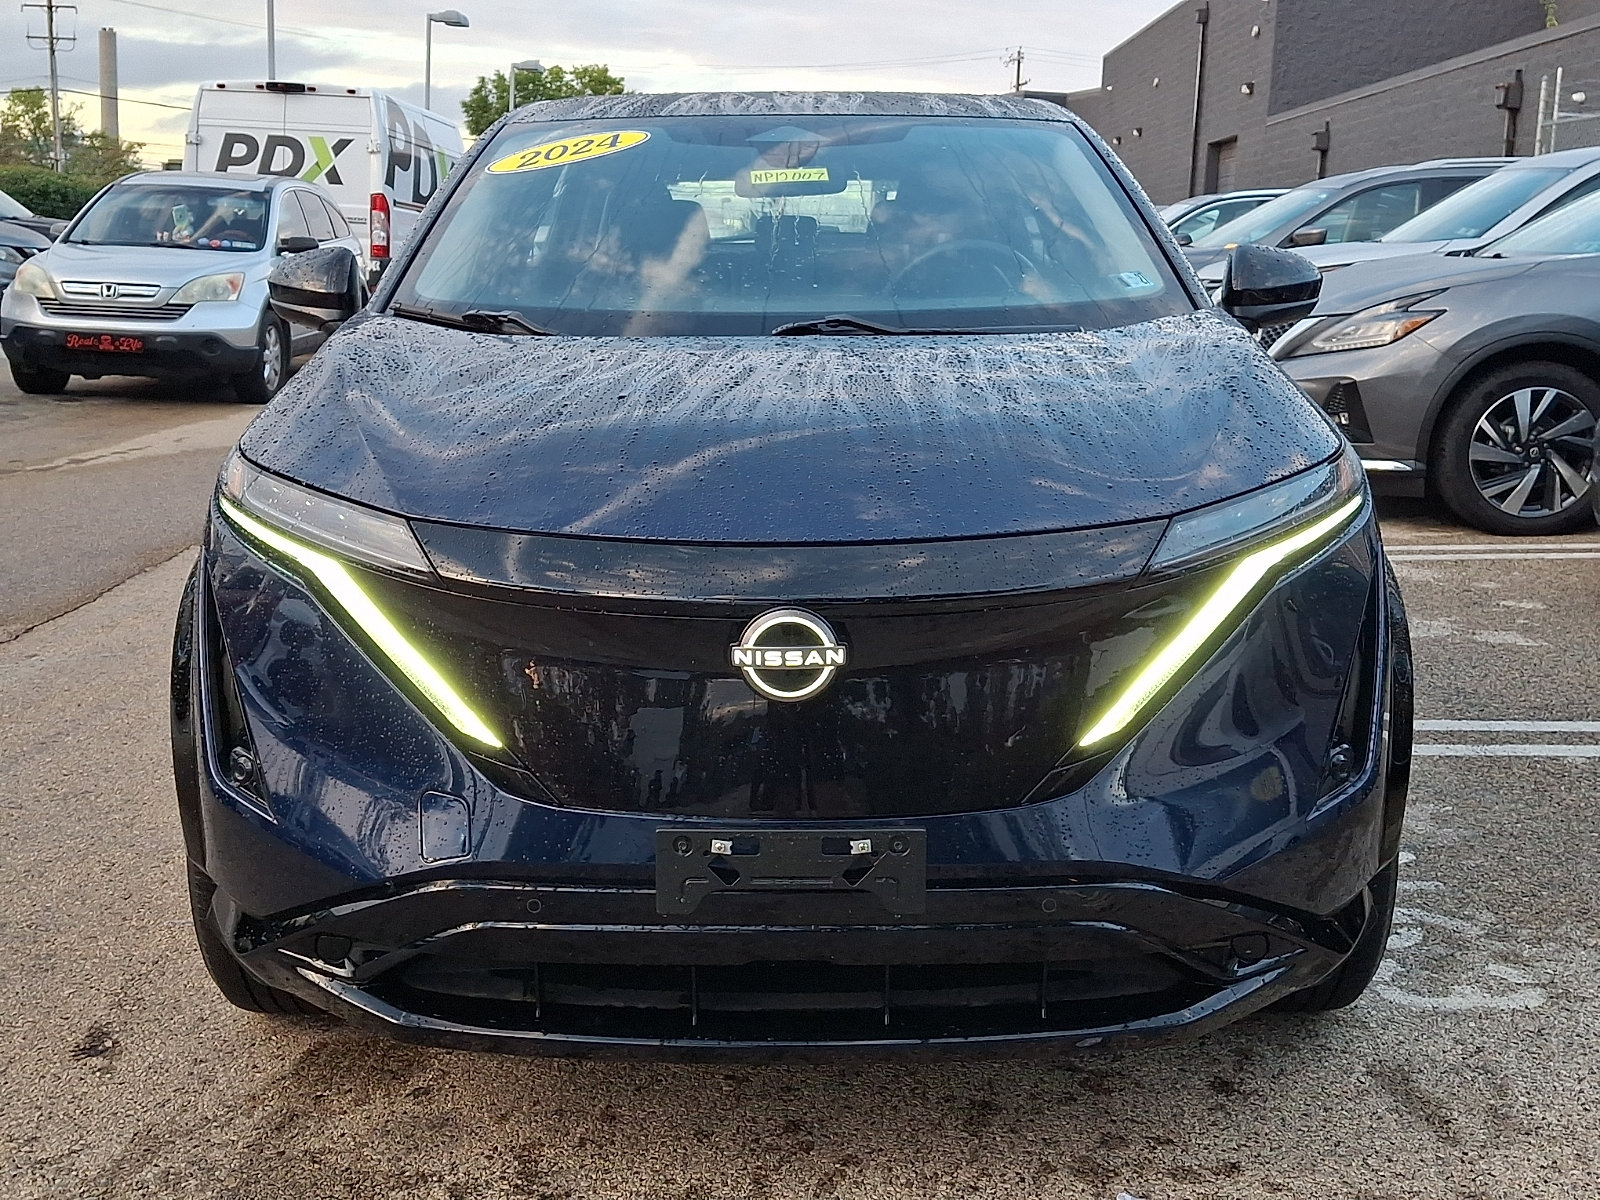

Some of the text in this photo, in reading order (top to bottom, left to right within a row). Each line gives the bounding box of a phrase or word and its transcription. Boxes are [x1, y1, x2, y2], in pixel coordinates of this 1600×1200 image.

[215, 132, 354, 186] PDX
[516, 133, 622, 169] 2024
[734, 649, 844, 667] NISSAN
